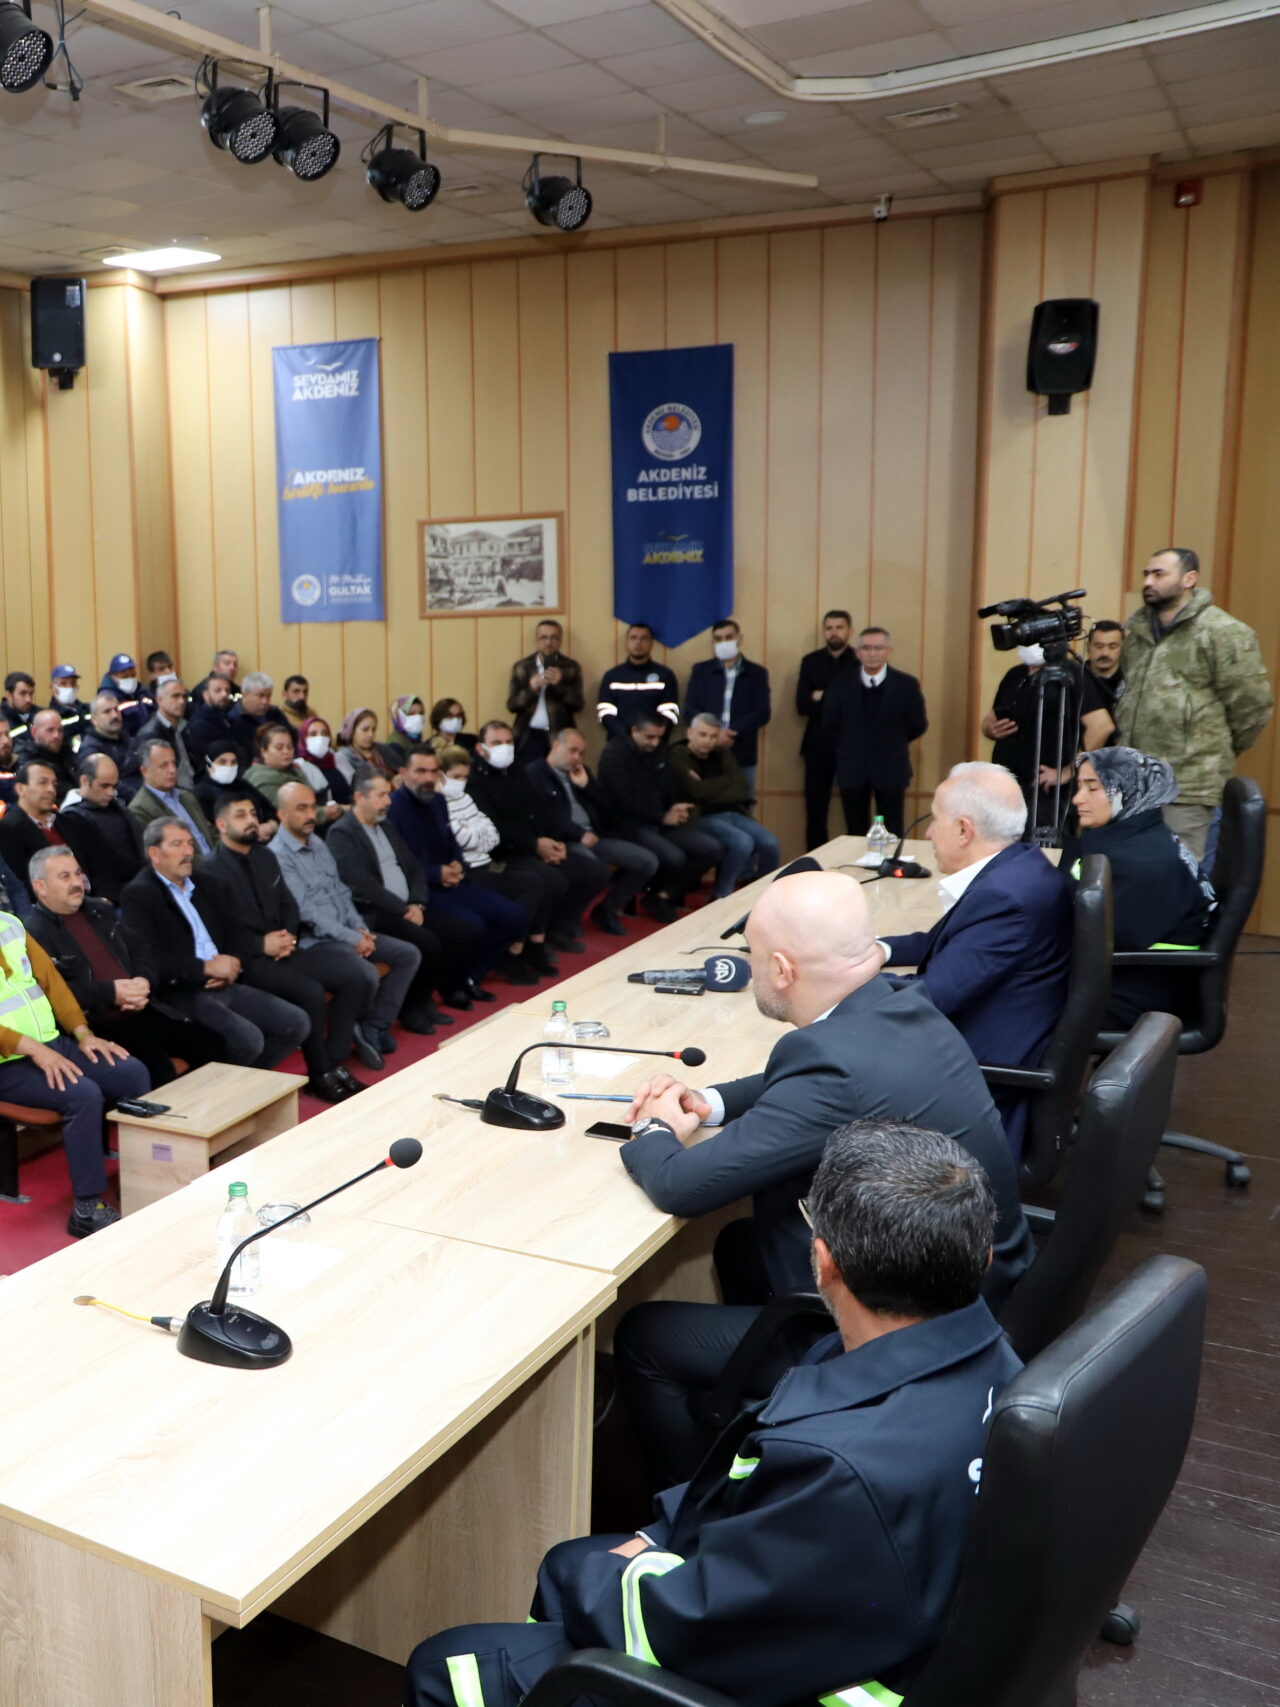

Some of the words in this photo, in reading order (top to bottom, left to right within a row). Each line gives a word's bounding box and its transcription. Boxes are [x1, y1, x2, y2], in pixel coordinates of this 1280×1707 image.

[292, 370, 359, 388] SEVDAMIZ
[637, 464, 707, 483] AKDENİZ
[627, 481, 719, 502] BELEDİYESİ
